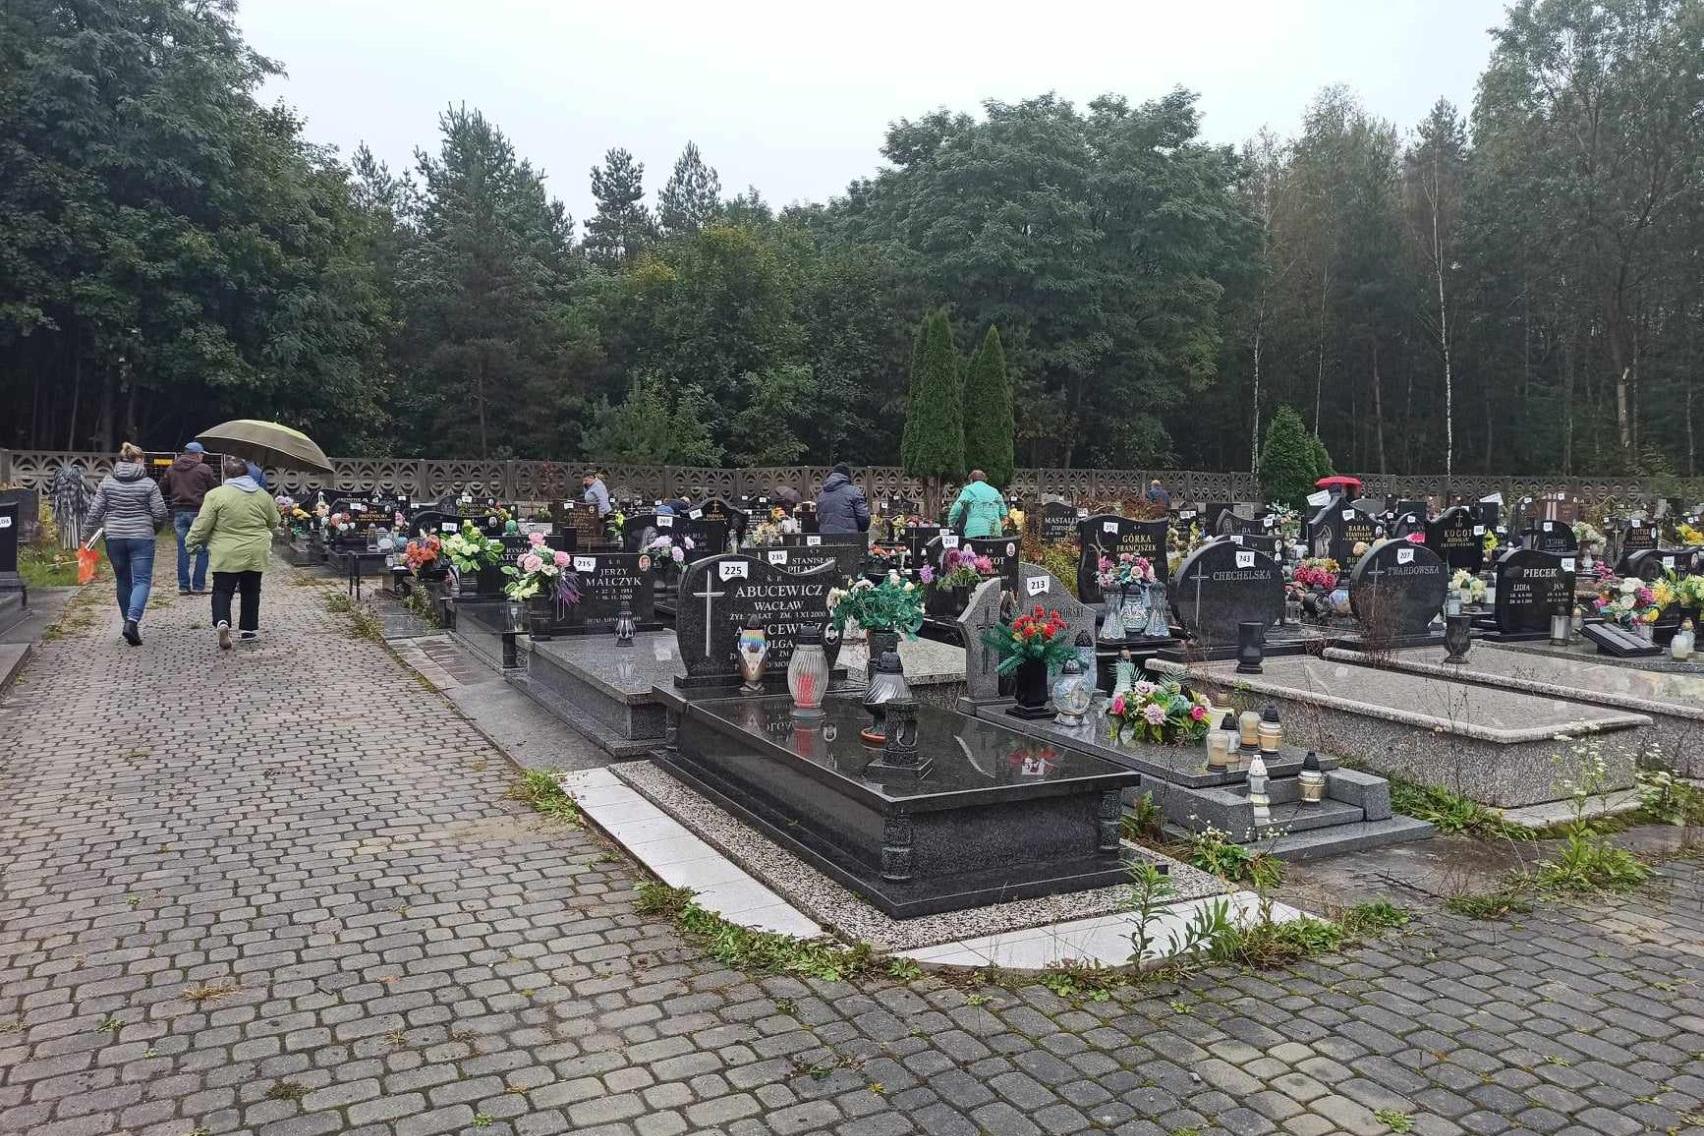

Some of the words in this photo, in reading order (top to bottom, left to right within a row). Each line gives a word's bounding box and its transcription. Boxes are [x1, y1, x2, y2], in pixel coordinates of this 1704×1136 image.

[1122, 533, 1152, 543] GÓRKA
[600, 568, 628, 577] JERZY
[725, 566, 742, 575] 225
[1213, 570, 1271, 580] CHECHELSKA
[1523, 568, 1557, 578] PIECEK
[586, 577, 642, 587] MALCZYK
[1031, 581, 1045, 589] 213
[735, 584, 823, 598] ABUCEWICZ
[754, 600, 804, 611] WACŁAW
